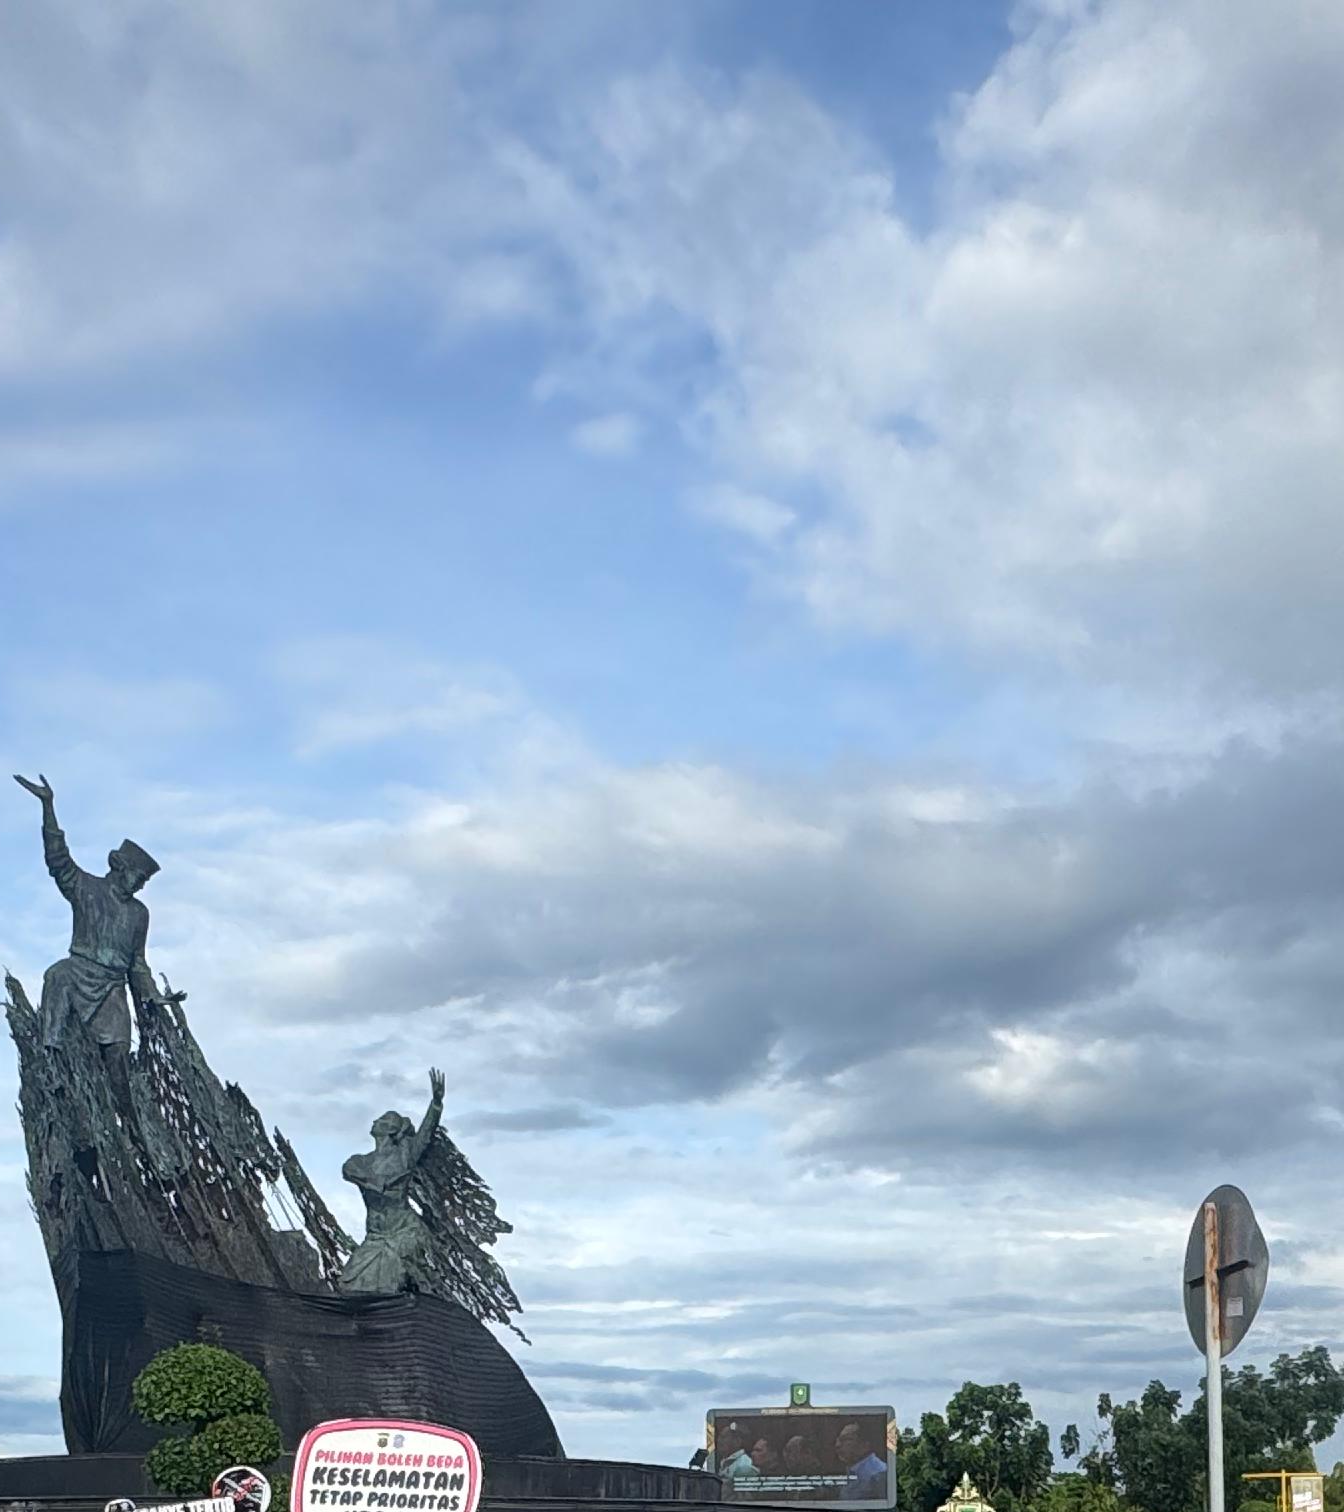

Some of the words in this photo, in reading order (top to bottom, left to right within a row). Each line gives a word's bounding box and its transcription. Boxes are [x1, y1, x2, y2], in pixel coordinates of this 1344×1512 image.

[315, 1449, 374, 1465] PILIHAN
[377, 1453, 423, 1466] BOLEH
[426, 1455, 464, 1469] BEDA
[312, 1466, 465, 1491] KESELAMATAN
[310, 1489, 363, 1506] TETAP
[366, 1491, 460, 1511] PRIORITAS
